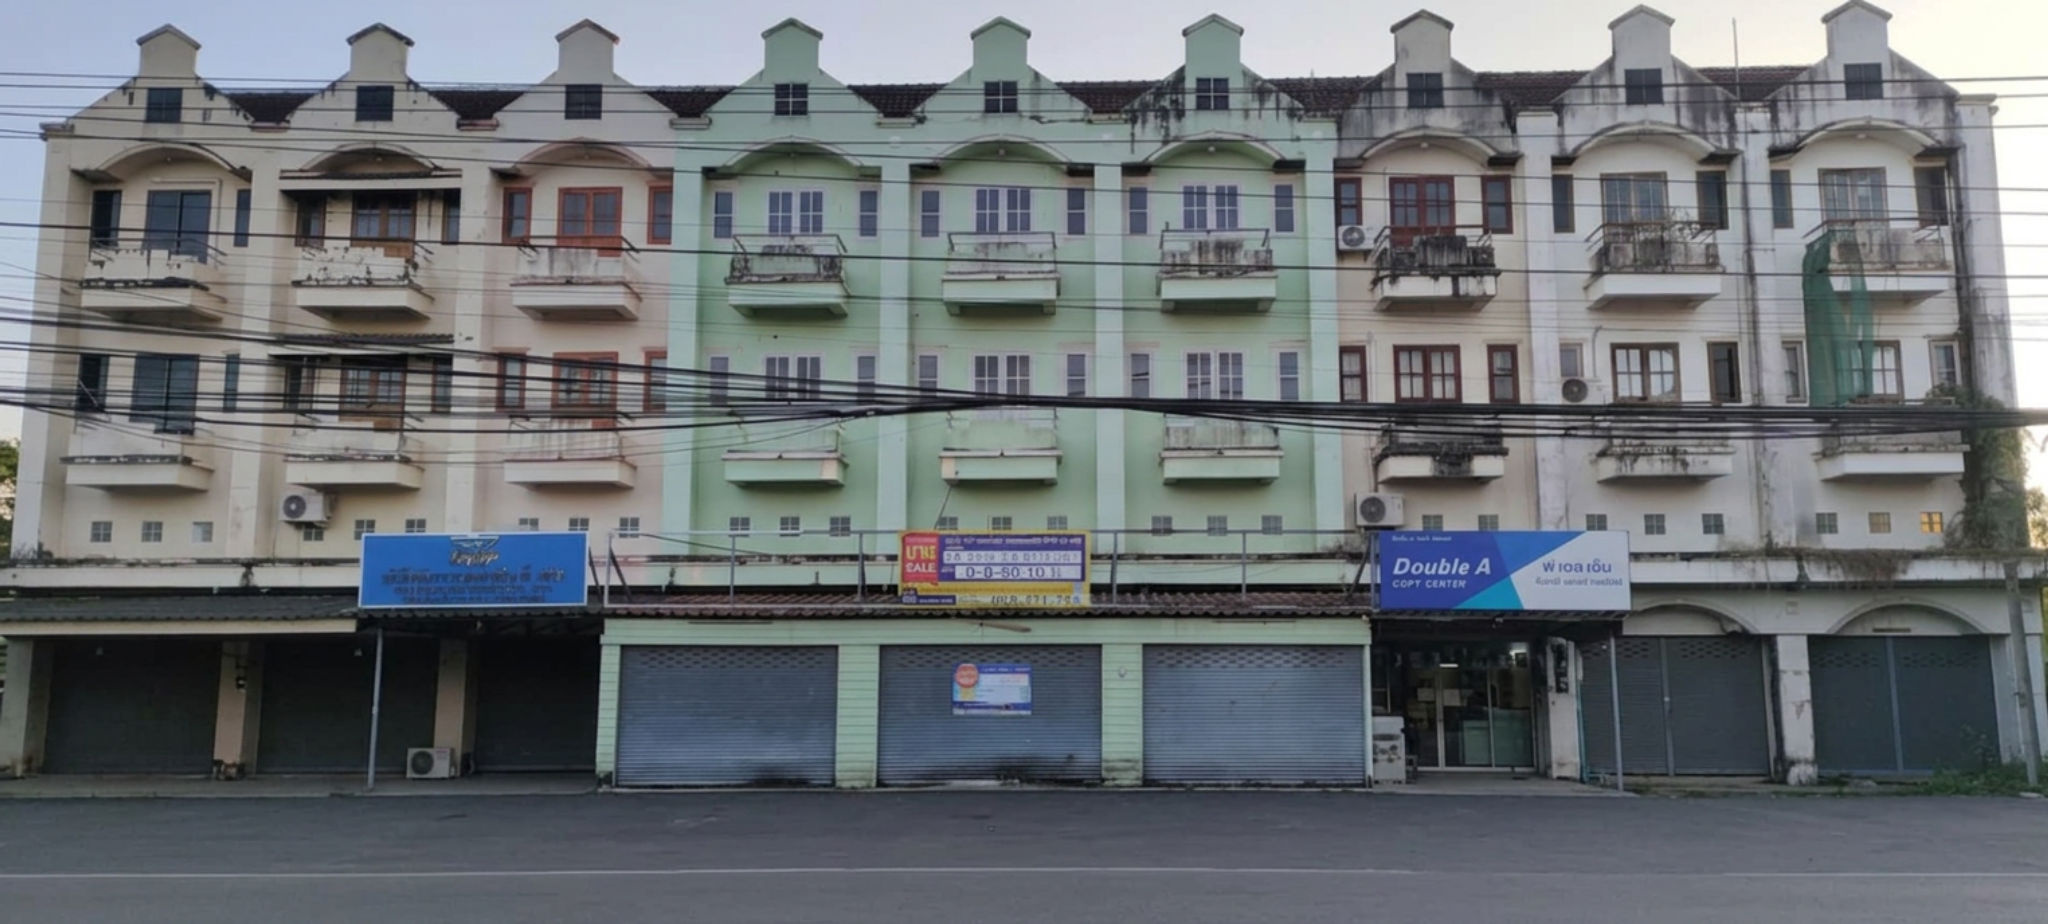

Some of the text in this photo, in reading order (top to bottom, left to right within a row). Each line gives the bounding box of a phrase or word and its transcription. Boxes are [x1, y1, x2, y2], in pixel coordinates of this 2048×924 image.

[905, 562, 937, 573] SALE
[1393, 557, 1491, 575] Double A
[1392, 579, 1467, 589] COPY CENTER
